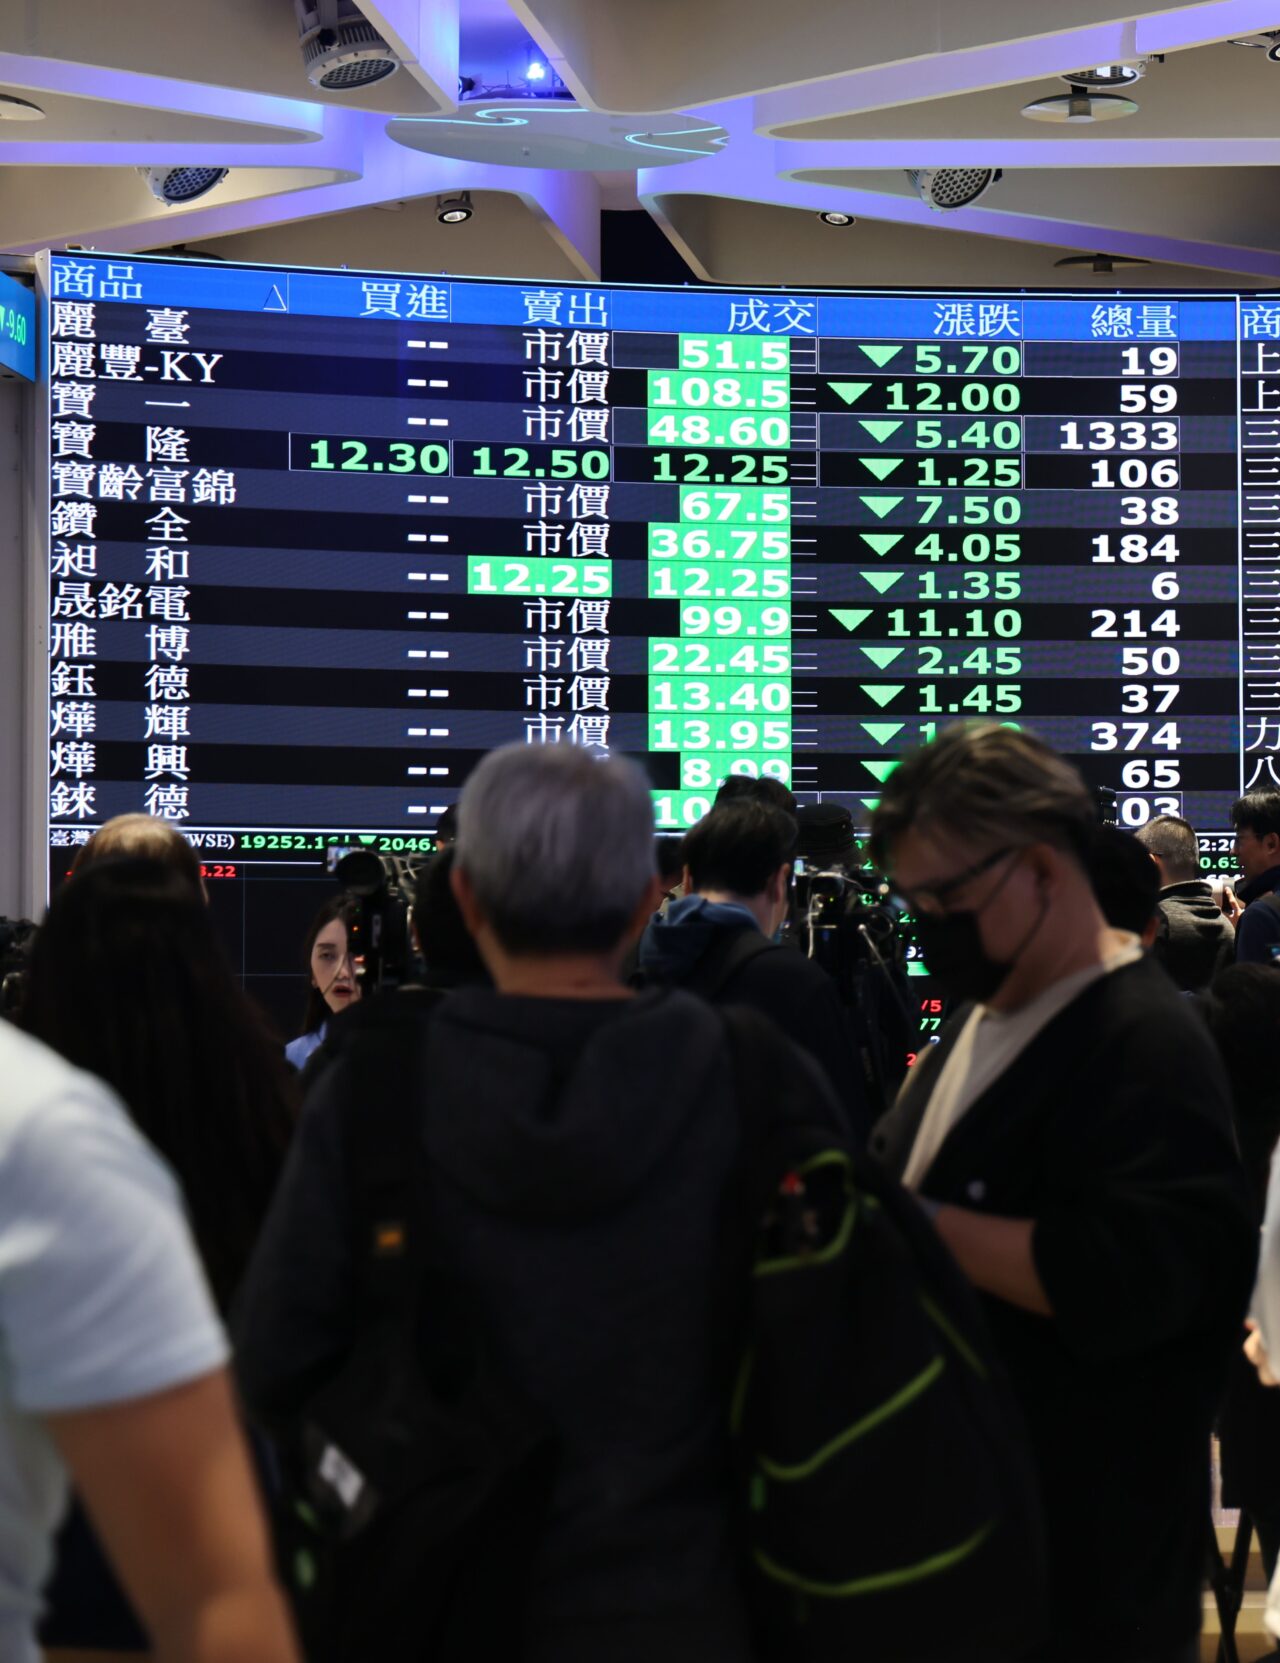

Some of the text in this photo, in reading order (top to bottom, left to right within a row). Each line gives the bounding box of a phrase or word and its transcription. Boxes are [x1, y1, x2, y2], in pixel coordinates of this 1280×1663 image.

[52, 261, 1176, 337] 商品 買進 賣出 成交 漲跌 總量
[523, 329, 1177, 375] 市價 51.5 5.70 19
[52, 342, 1177, 413] 麗豐-KY 108.5 12.00 59
[523, 406, 1178, 450] 市價 48.60 5.40 1333
[311, 440, 448, 473] 12.30
[474, 446, 611, 479] 12.50
[654, 453, 788, 484] 12.25
[918, 457, 1021, 487] 1.25
[1092, 459, 1178, 487] 106
[51, 460, 1179, 525] 寶齡富錦 67.5 7.50 38
[652, 529, 1179, 563] 36.75 4.05 184
[474, 563, 1179, 600] 12.25 12.25 1.35 6
[52, 582, 1180, 637] 晟銘電 99.9 11.10 214
[653, 644, 1180, 675] 22.45 2.45 50
[524, 675, 610, 710] 市價
[655, 682, 790, 712] 13.40
[920, 685, 1021, 712] 1.45
[1122, 685, 1179, 713] 37
[655, 720, 1181, 750] 13.95 374
[1123, 760, 1180, 788] 65
